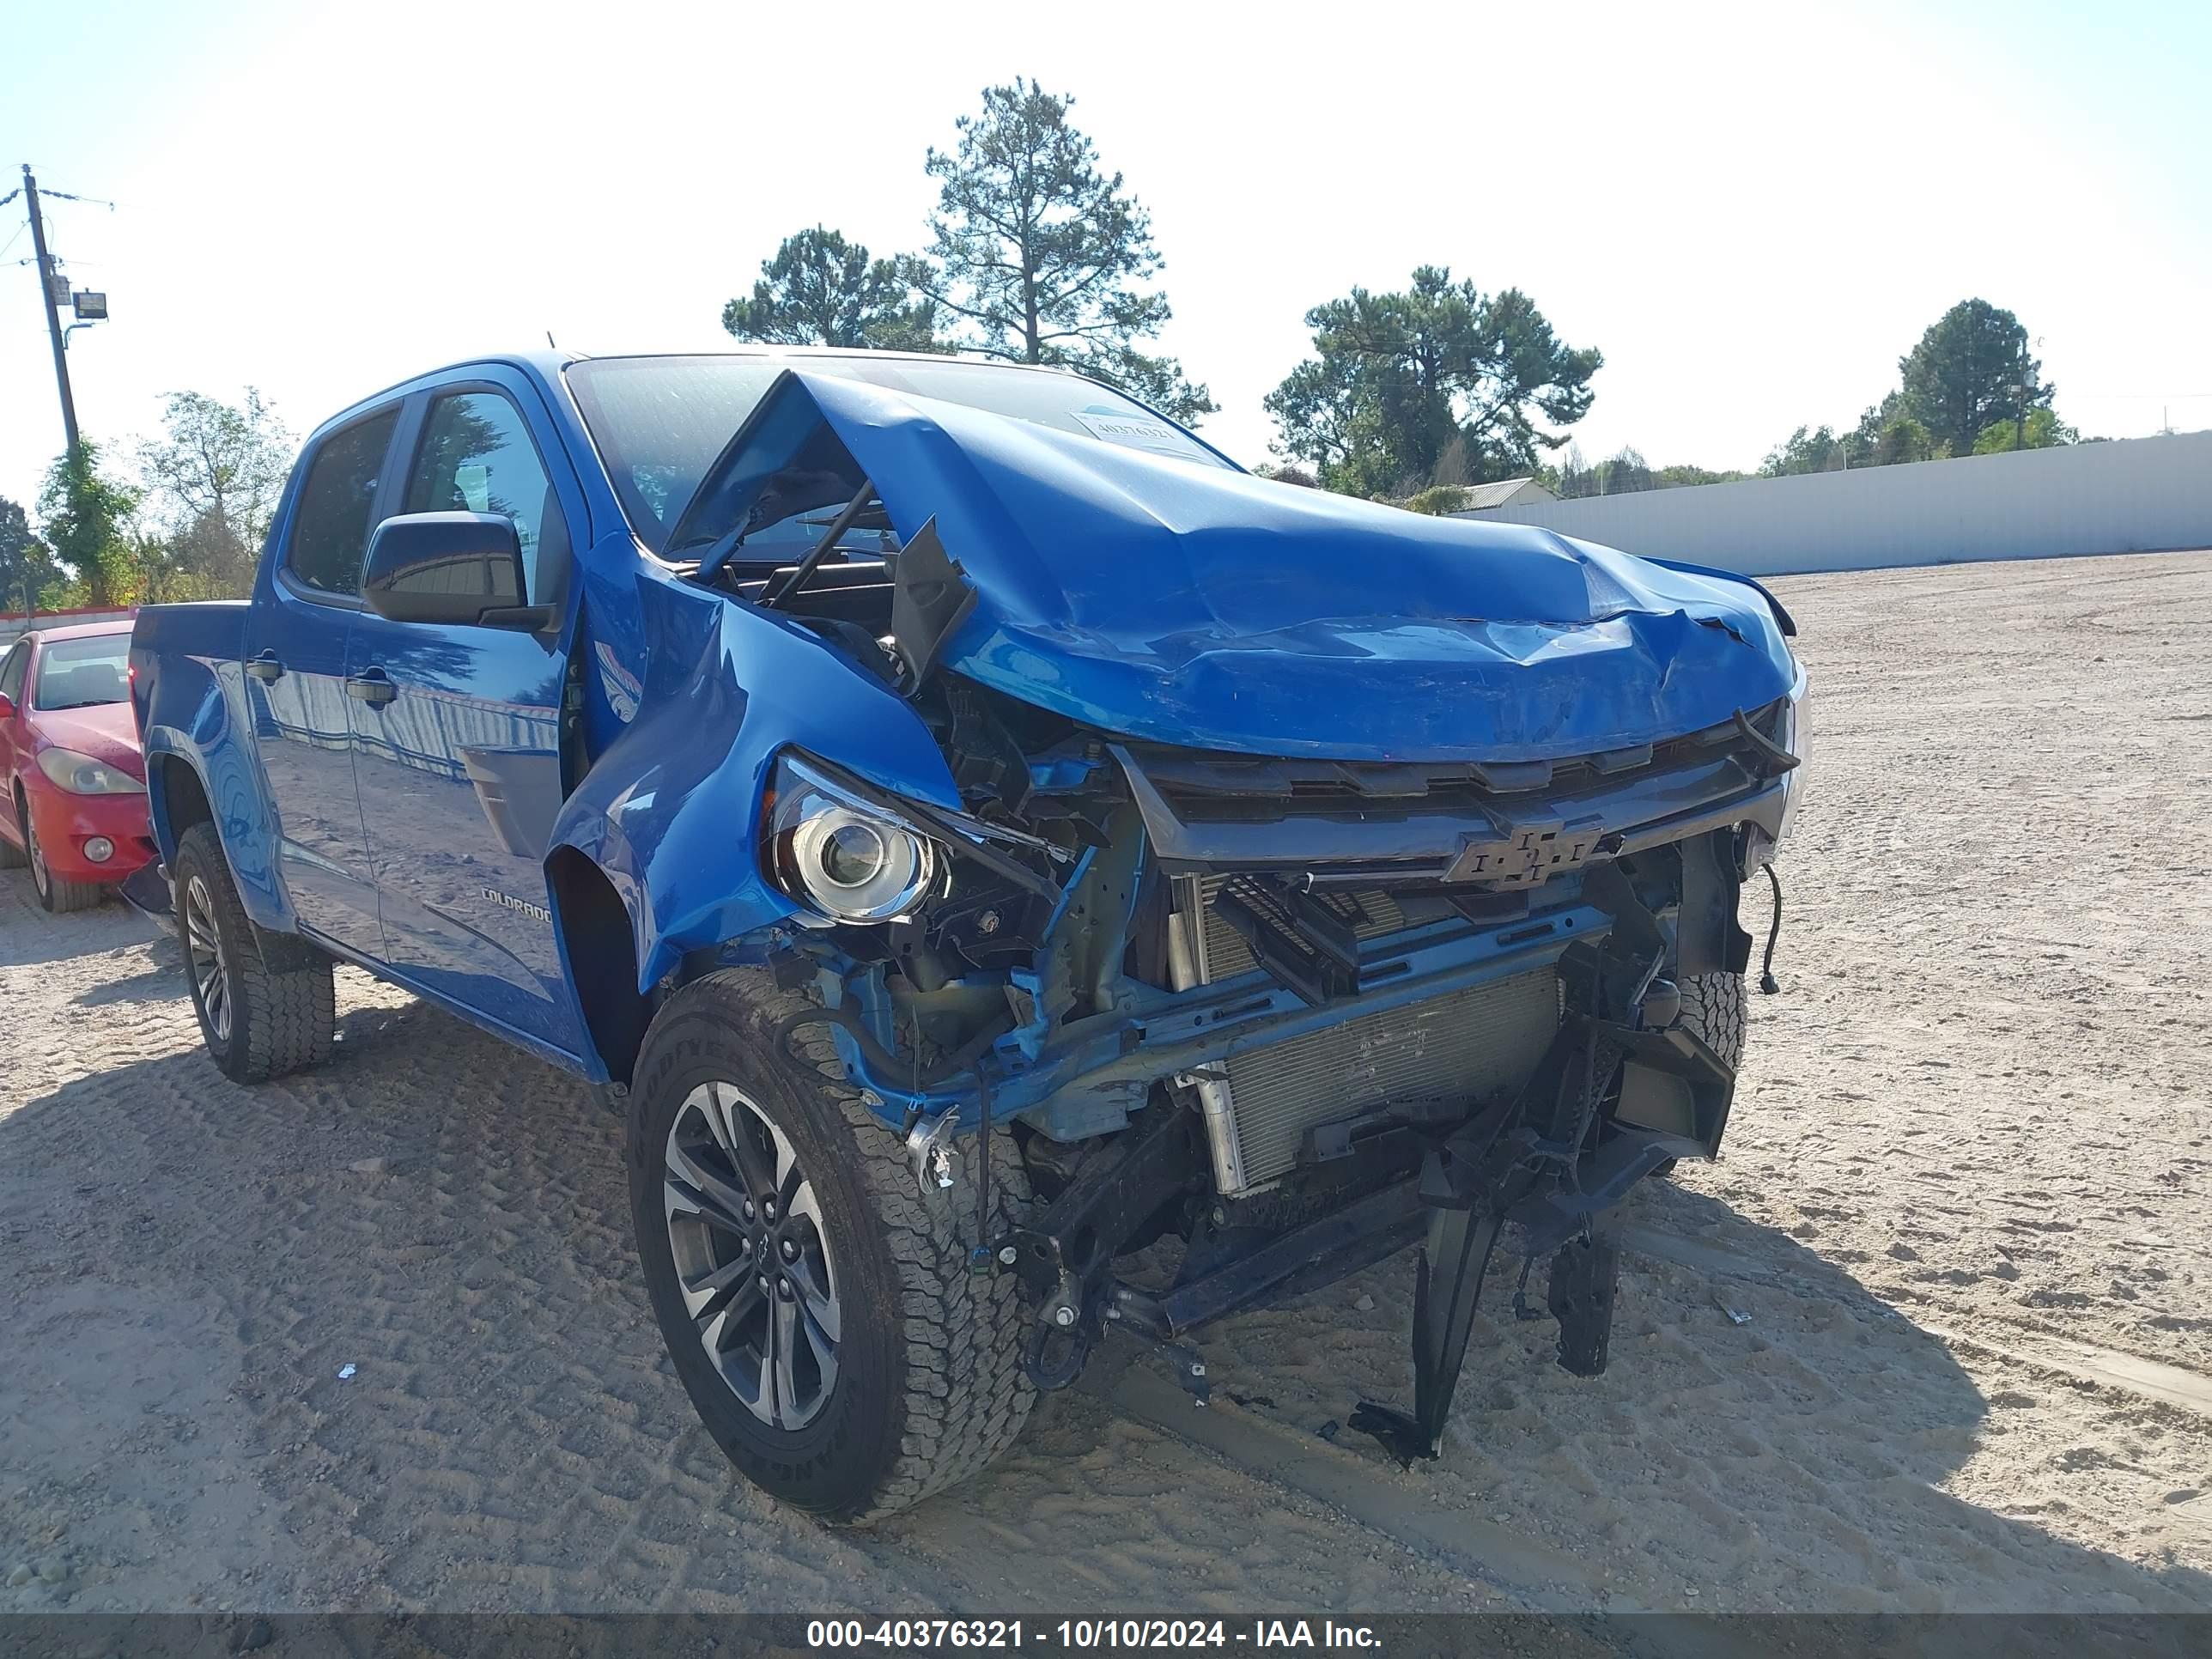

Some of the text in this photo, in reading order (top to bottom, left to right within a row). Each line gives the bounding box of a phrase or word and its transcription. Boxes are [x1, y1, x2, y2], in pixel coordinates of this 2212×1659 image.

[1098, 424, 1175, 439] 40376321
[481, 886, 553, 924] COLORADO
[634, 1038, 764, 1170] GOODYE
